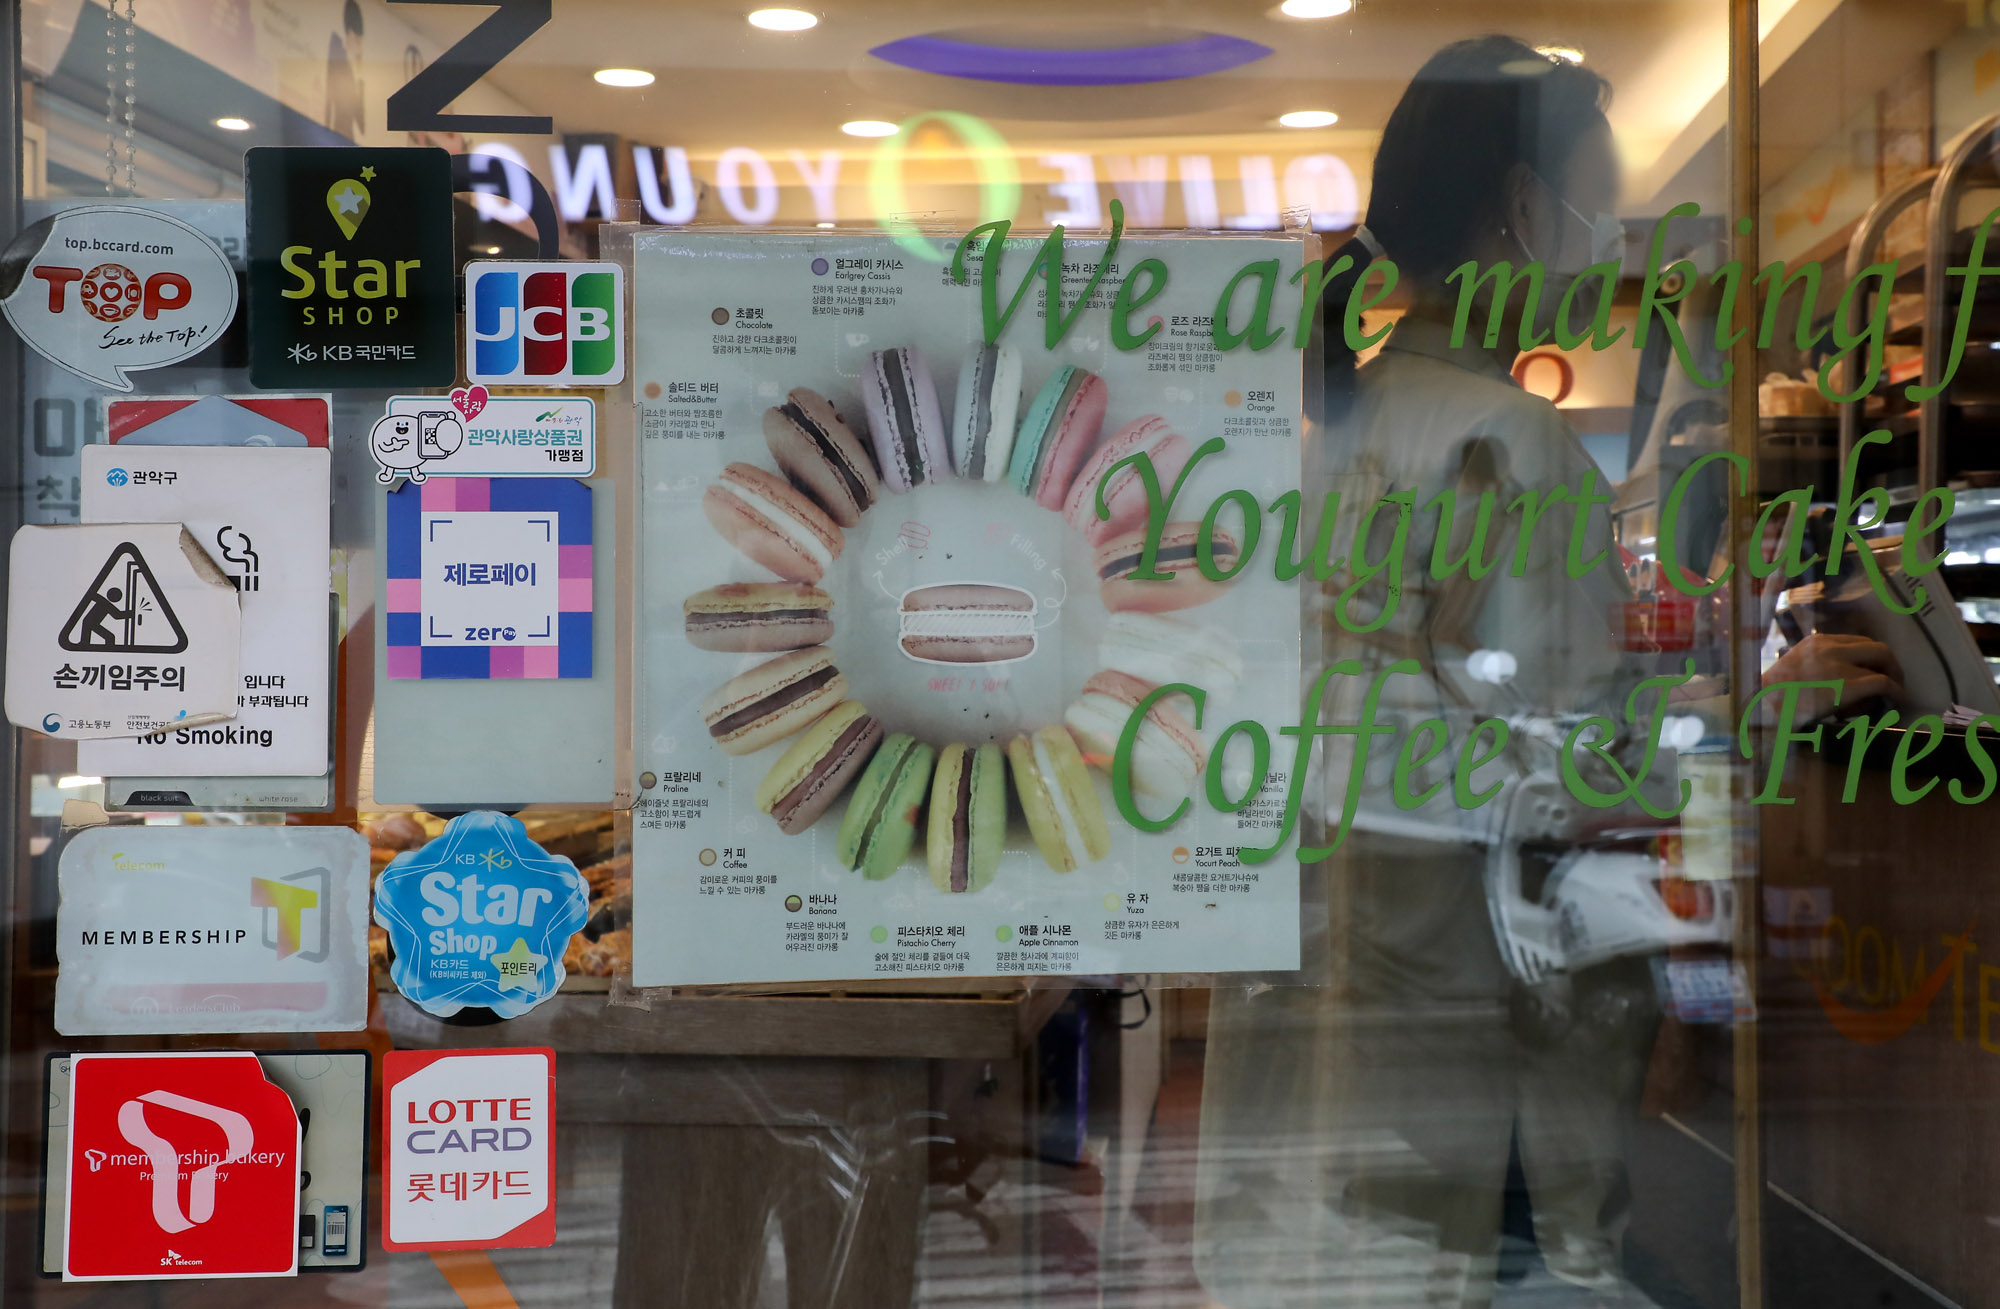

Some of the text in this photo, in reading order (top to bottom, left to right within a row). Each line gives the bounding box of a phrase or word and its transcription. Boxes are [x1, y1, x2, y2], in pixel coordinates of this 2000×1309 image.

[65, 237, 174, 255] top.bccard.com
[835, 258, 903, 270] 얼그레이 카시스
[1061, 263, 1080, 273] 녹차
[281, 245, 420, 300] Star
[835, 271, 890, 281] Earlgrey Cassis
[33, 263, 192, 322] TOP
[812, 285, 833, 294] 진하게
[950, 198, 1169, 350] We
[1211, 250, 1400, 350] are
[1449, 203, 1889, 402] making
[303, 306, 400, 326] SHOP
[736, 308, 764, 319] 초콜릿
[843, 307, 865, 316] 마카롱
[474, 306, 613, 343] JCB
[735, 321, 773, 329] Chocolate
[1171, 316, 1189, 326] 로즈
[98, 326, 135, 349] See
[139, 328, 163, 345] the
[712, 335, 797, 344] 진하고 강한 다크초콜릿이
[712, 345, 797, 355] 달콤하게 느껴지는 마카롱
[1148, 342, 1183, 351] 장미크림의
[1148, 353, 1176, 361] 라즈베리
[1195, 364, 1215, 373] 마카롱
[668, 382, 718, 393] 솔티드 버터
[668, 395, 717, 403] Salted&Butter
[1247, 391, 1275, 401] 오렌지
[452, 394, 470, 409] 서울
[463, 401, 482, 415] 사랑
[1247, 403, 1275, 413] Orange
[644, 409, 691, 418] 고소한 버터와
[644, 420, 666, 428] 소금이
[468, 429, 583, 446] 관악사랑상품권
[703, 431, 726, 440] 마카롱
[1224, 428, 1252, 436] 오렌지가
[1271, 428, 1292, 437] 마카롱
[545, 449, 584, 462] 가맹점
[132, 470, 178, 485] 관악구
[1094, 429, 1956, 633] Yougurt Cake
[1010, 534, 1047, 571] Filling
[443, 562, 536, 587] 제로페이
[53, 663, 185, 692] 손끼임주의
[244, 675, 286, 689] 입니다
[249, 695, 309, 708] 부과됩니다
[68, 719, 111, 729] 고용노동부
[176, 726, 273, 748] Smoking
[1112, 658, 1510, 866] Coffee
[664, 771, 701, 783] 프랄리네
[664, 784, 689, 792] Praline
[140, 794, 179, 802] black suit
[258, 795, 280, 803] white
[640, 809, 701, 818] 고소함이 부드럽게
[664, 821, 686, 829] 마카롱
[1195, 847, 1222, 857] 요거트
[455, 854, 475, 865] KB
[723, 860, 748, 868] Coffee
[1219, 859, 1240, 867] Peach
[114, 860, 165, 872] telecom
[700, 875, 728, 884] 감미로운
[732, 875, 753, 884] 커피의
[717, 886, 724, 895] 수
[727, 886, 741, 895] 있는
[744, 886, 766, 895] 마카롱
[1172, 884, 1250, 892] 복숭아 더한 마카롱
[420, 871, 553, 927] Star
[809, 894, 837, 905] 바나나
[809, 907, 837, 915] Banana
[1127, 906, 1144, 914] Yuza
[786, 921, 846, 930] 부드러운 바나나에
[1104, 920, 1179, 929] 상큼한 유자가 은은하게
[898, 925, 965, 937] 피스타치오 체리
[1019, 925, 1071, 936] 애플 시나몬
[1120, 931, 1142, 940] 마카롱
[82, 929, 247, 946] MEMBERSHIP
[1019, 938, 1079, 947] Apple Cinnamon
[428, 928, 497, 960] Shop
[785, 943, 838, 952] 어우러진 마카롱
[897, 939, 956, 948] Pistachio Cherry
[908, 952, 930, 961] 체리를
[956, 951, 970, 960] 더욱
[1021, 952, 1048, 961] 청사과에
[431, 959, 469, 970] KB카드
[500, 962, 537, 976] 포인트리
[874, 963, 965, 972] 고소해진 피스타치오 마카롱
[997, 962, 1072, 971] 은은하게 퍼지는 마카롱
[408, 1098, 531, 1124] LOTTE
[407, 1127, 532, 1154] CARD
[407, 1170, 532, 1203] 롯데카드
[160, 1258, 172, 1266] SK
